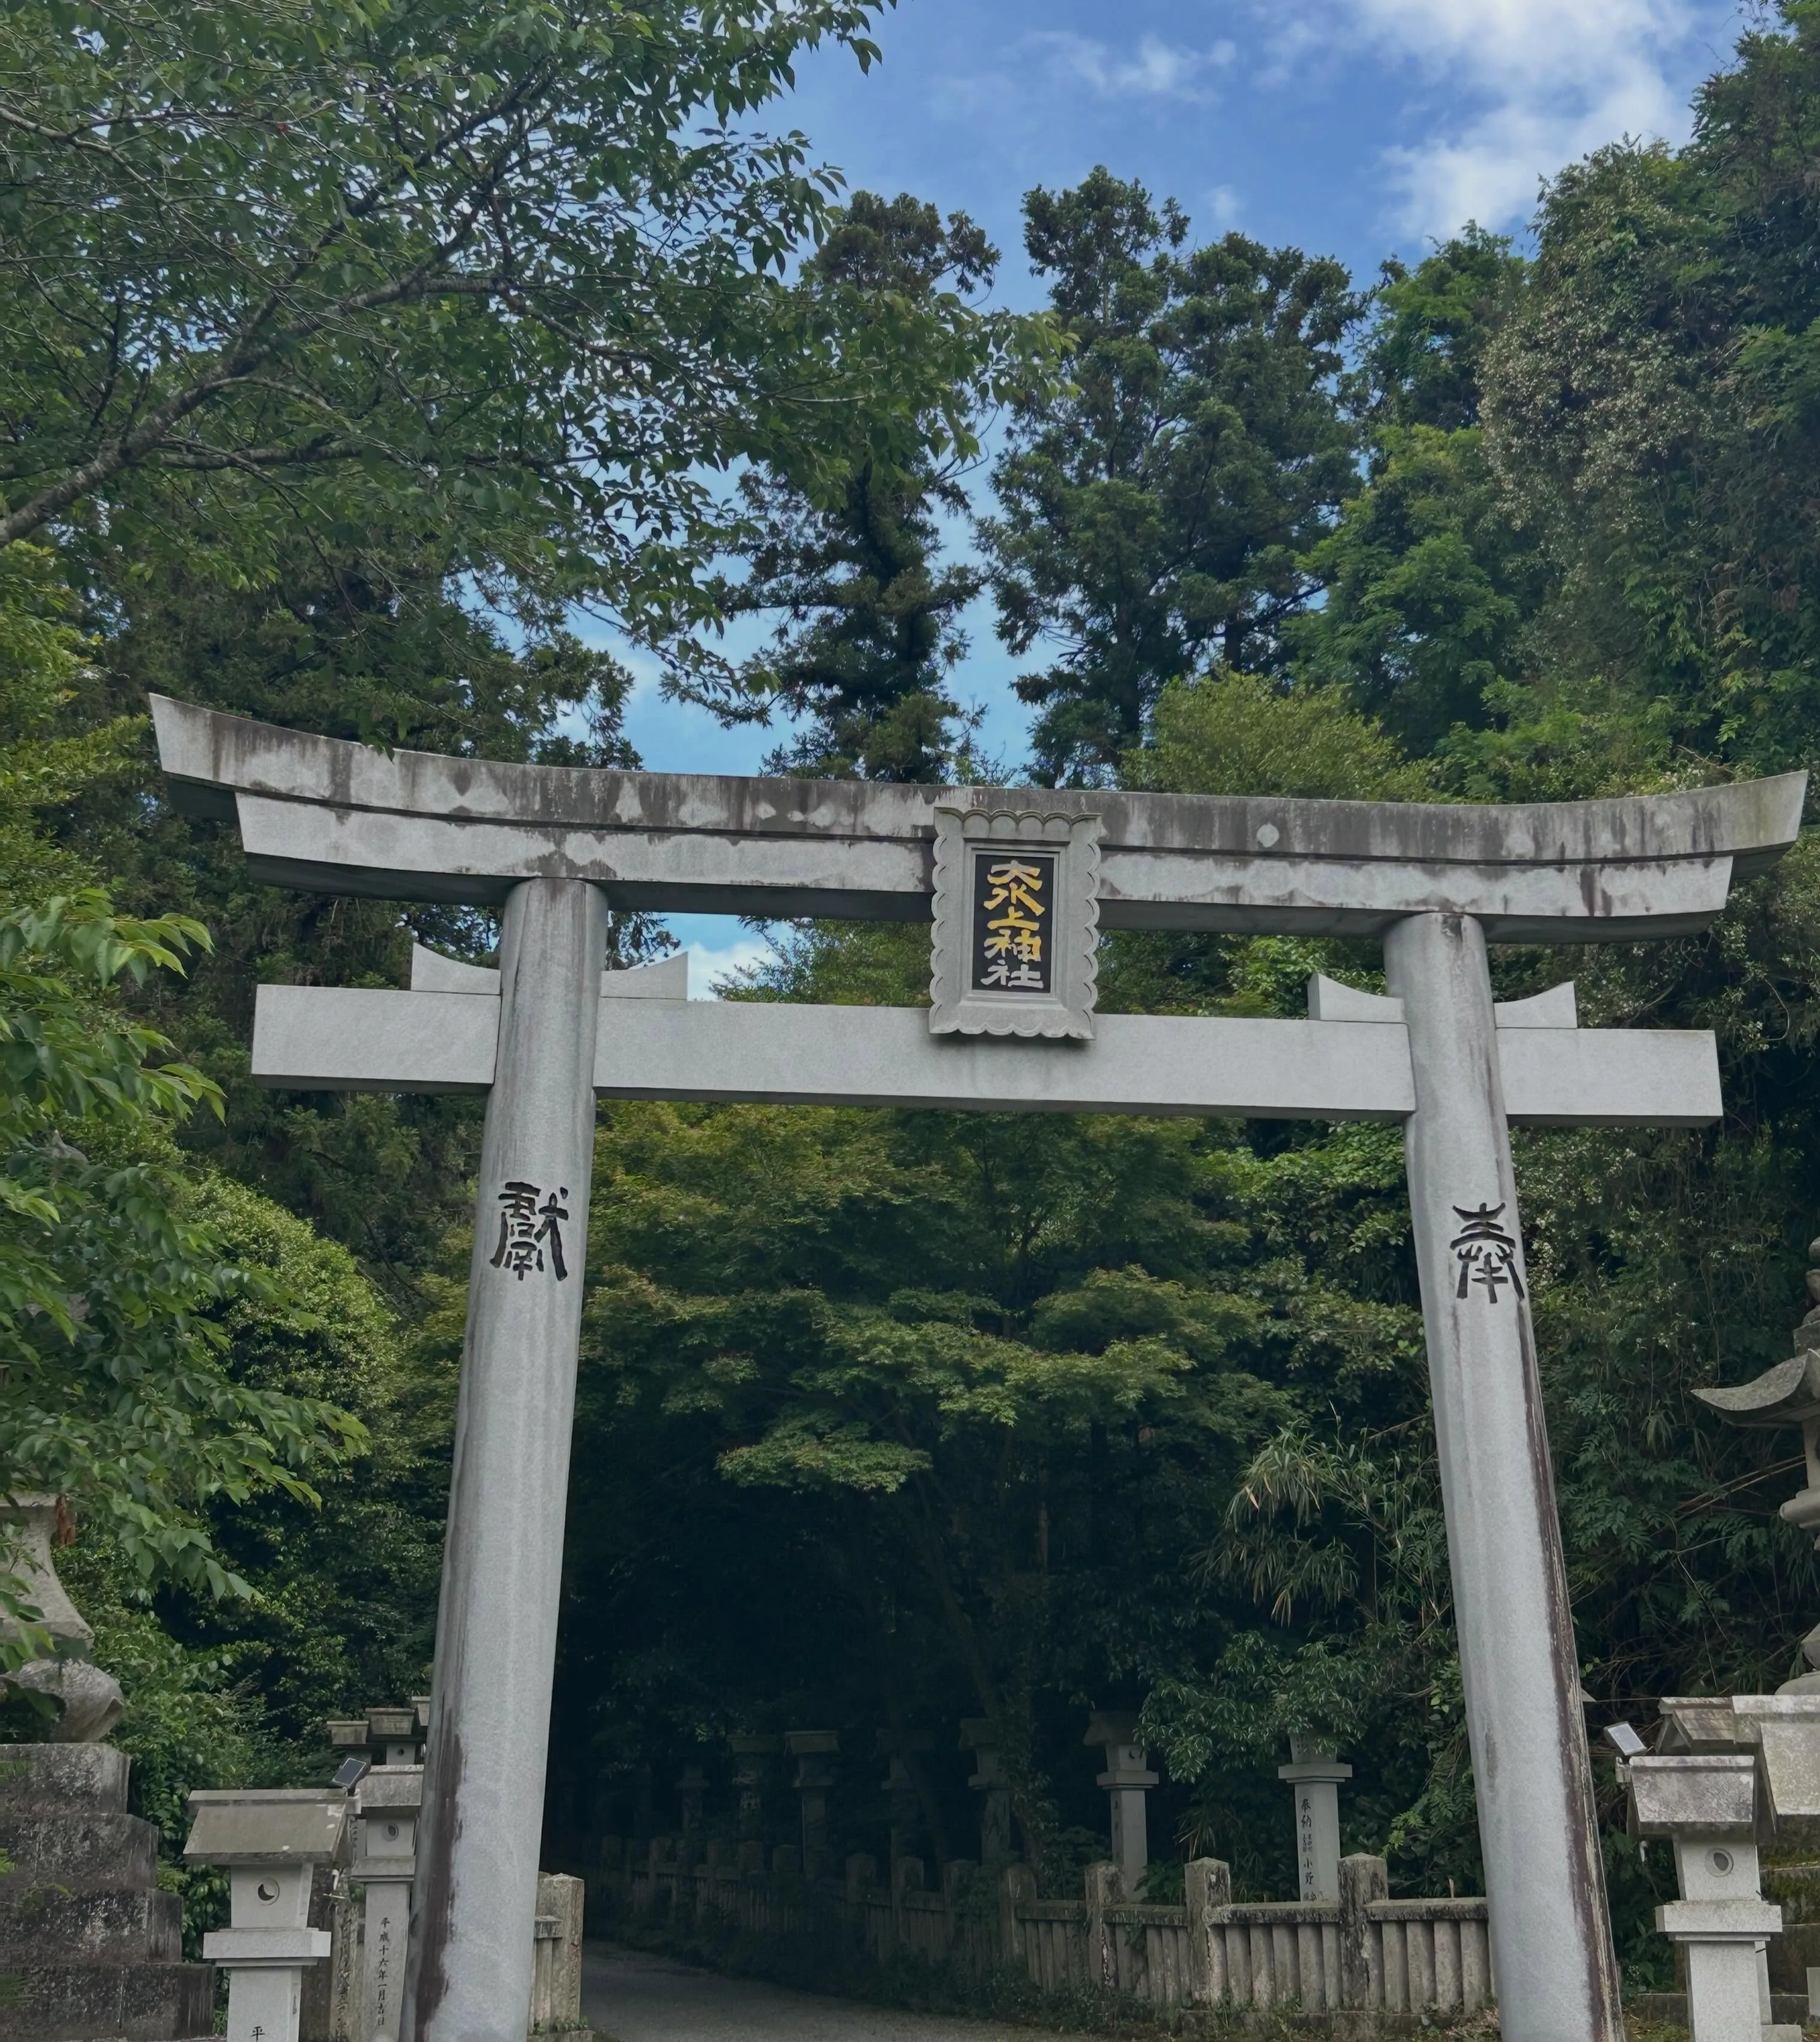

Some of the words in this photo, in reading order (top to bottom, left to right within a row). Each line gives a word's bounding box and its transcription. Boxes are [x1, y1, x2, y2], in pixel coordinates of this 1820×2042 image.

[980, 860, 1045, 988] 大水上神社
[1449, 1202, 1525, 1304] 奉
[250, 2026, 265, 2042] 平
